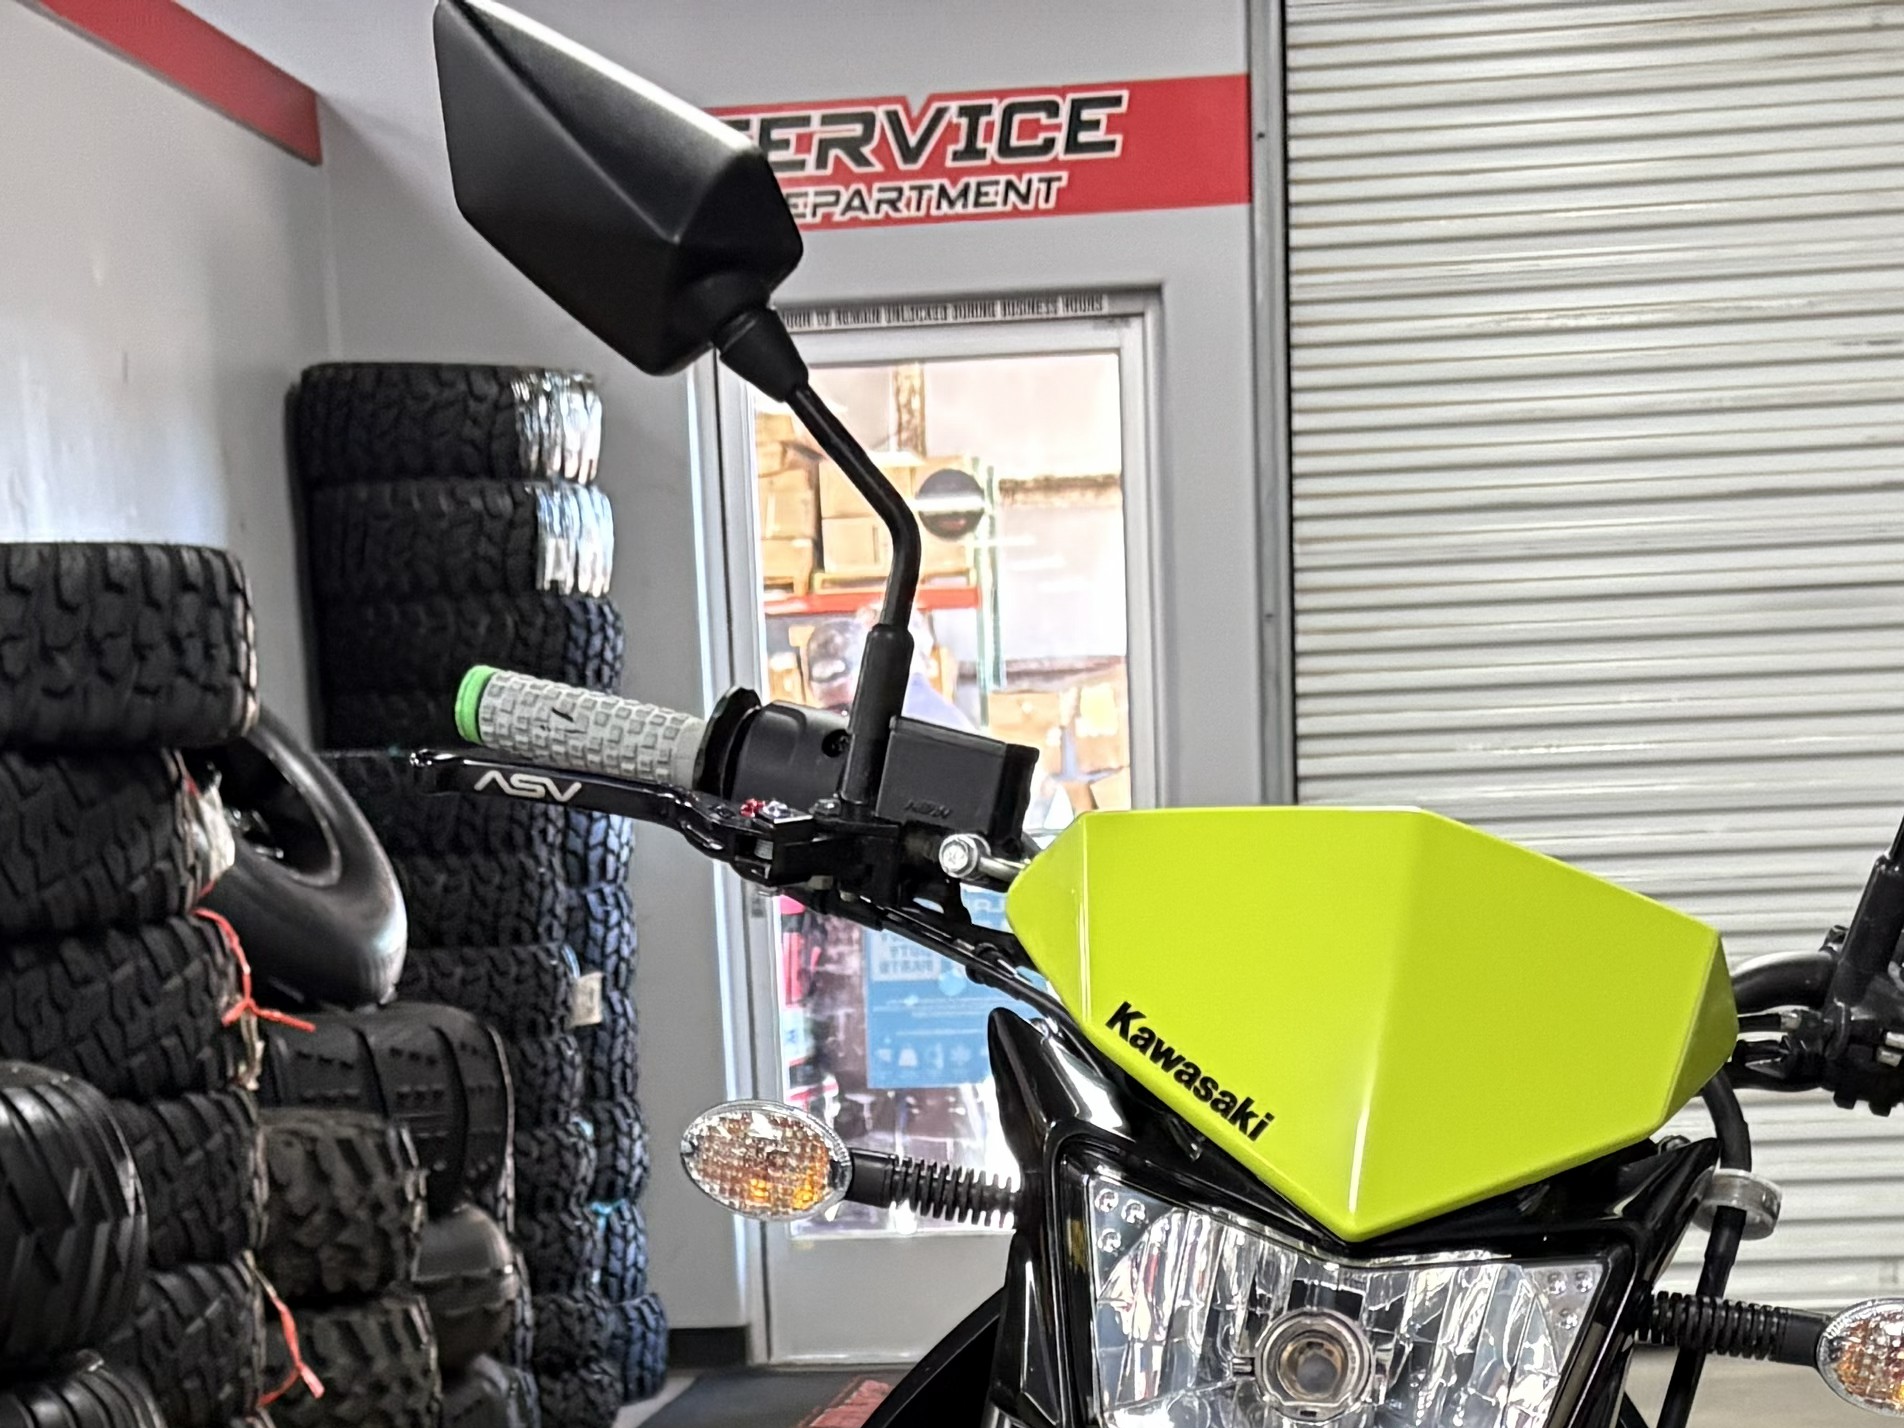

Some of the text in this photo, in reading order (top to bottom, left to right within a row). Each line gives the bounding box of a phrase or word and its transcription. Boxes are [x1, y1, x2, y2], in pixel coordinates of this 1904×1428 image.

[786, 170, 1069, 221] EPARTMENT
[473, 769, 583, 803] ASV
[1105, 1001, 1275, 1142] Kawasaki
